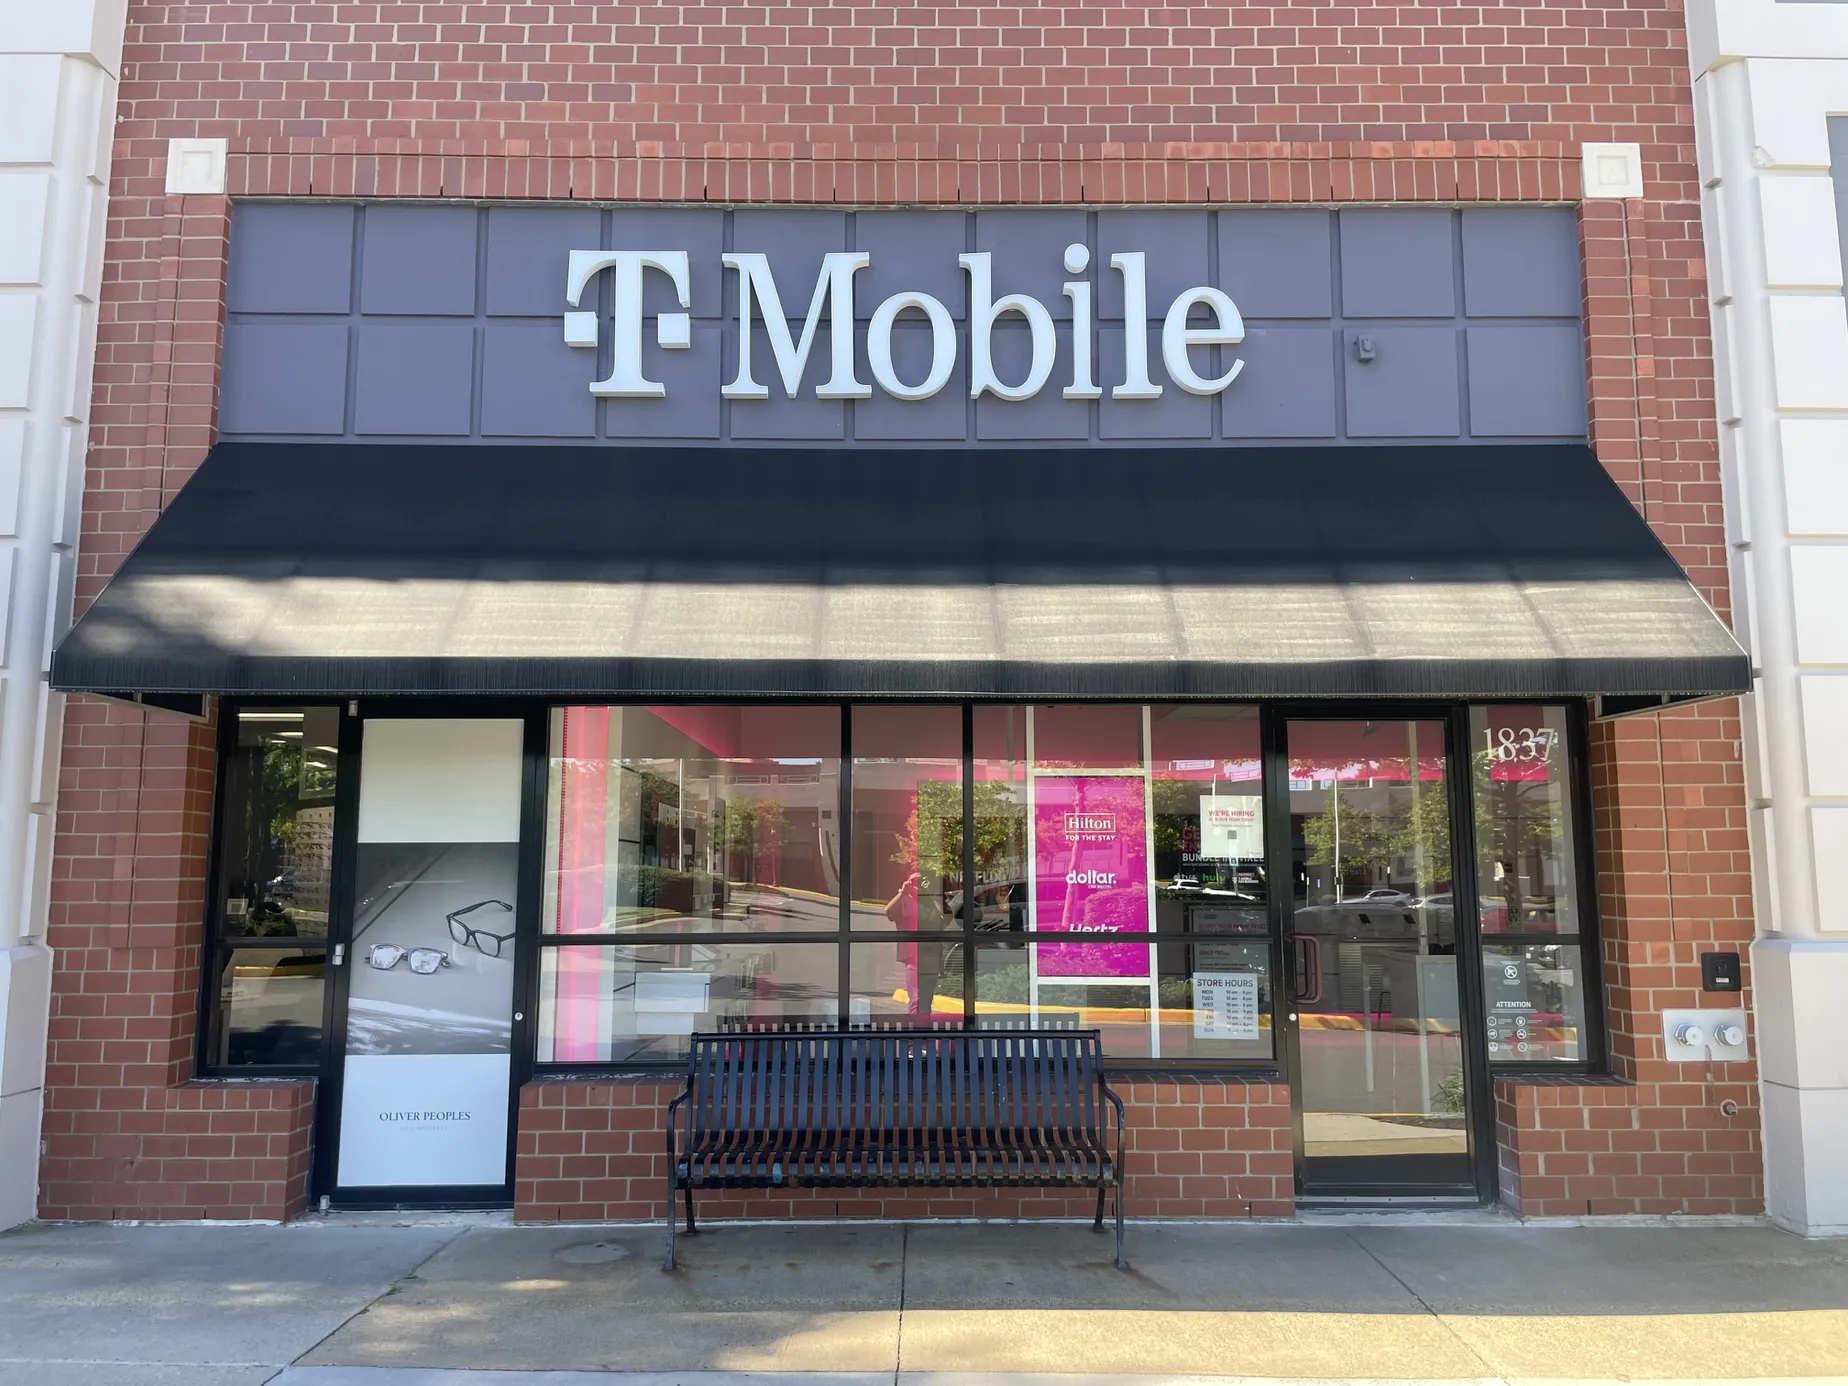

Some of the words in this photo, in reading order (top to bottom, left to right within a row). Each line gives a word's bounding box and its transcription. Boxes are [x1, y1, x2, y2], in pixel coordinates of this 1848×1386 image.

[1483, 727, 1555, 761] 1837
[1068, 817, 1111, 829] Hilton
[1065, 834, 1080, 842] FOR
[1081, 834, 1096, 842] THE
[1098, 834, 1116, 842] STAY
[1197, 978, 1224, 987] STORE
[1225, 979, 1254, 988] HOURS
[379, 1111, 420, 1121] OLIVER
[423, 1111, 471, 1121] PEOPLES
